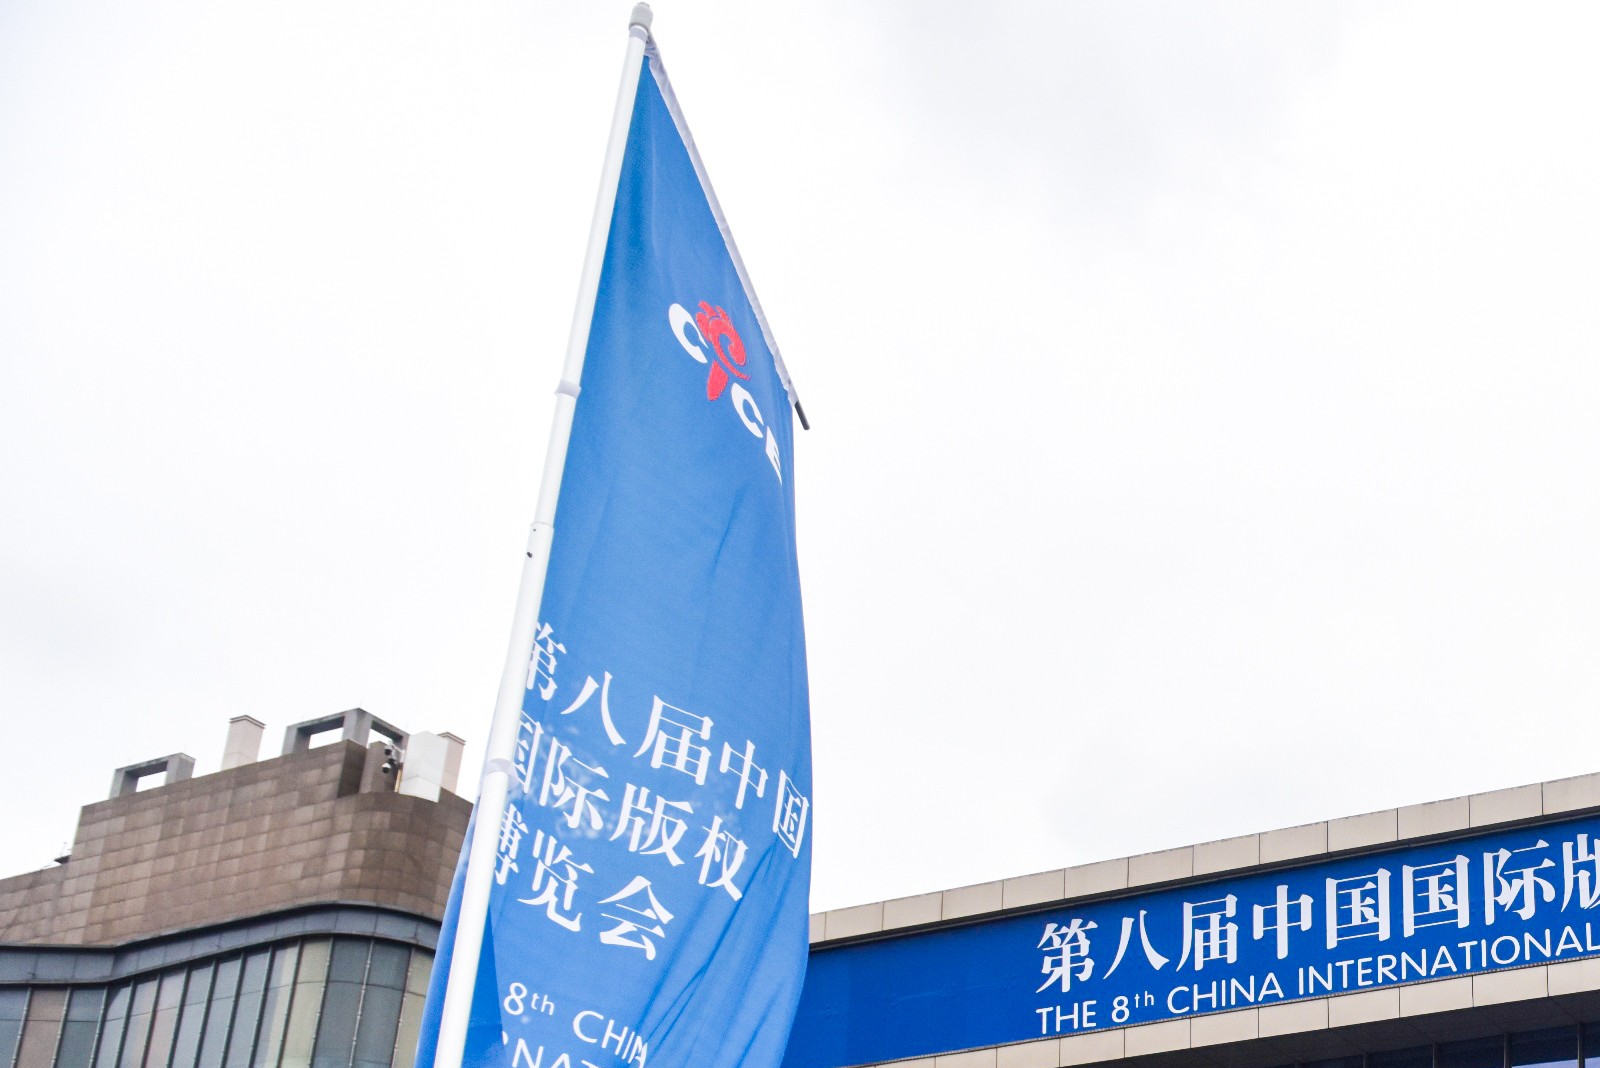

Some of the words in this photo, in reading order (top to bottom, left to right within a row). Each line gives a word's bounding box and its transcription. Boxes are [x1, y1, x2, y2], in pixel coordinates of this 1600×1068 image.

[503, 982, 555, 1016] 8th
[1036, 1001, 1098, 1035] THE
[1111, 991, 1156, 1024] 8th
[1167, 970, 1285, 1014] CHINA
